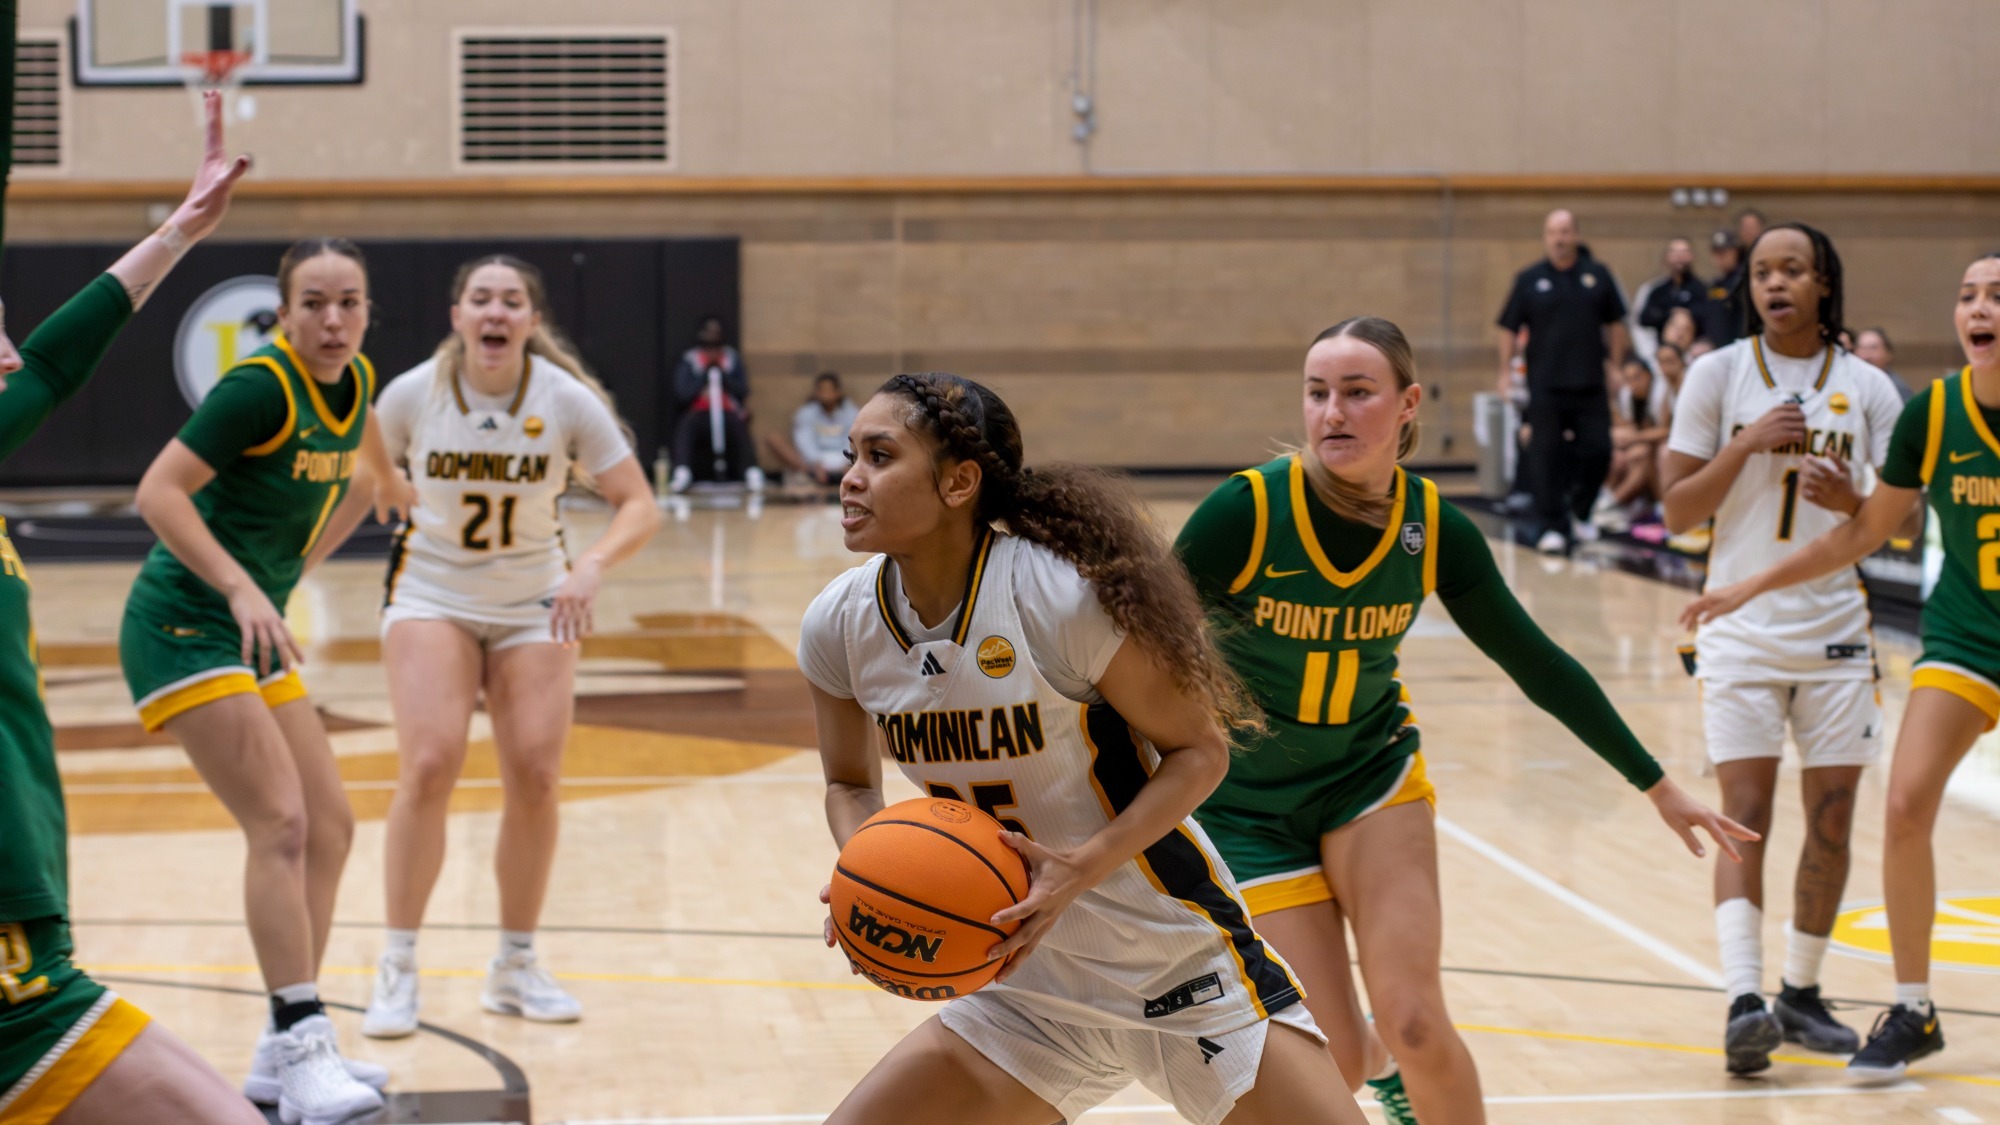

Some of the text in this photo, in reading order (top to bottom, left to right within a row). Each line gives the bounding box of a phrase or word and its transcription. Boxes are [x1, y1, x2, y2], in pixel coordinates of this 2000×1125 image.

[426, 451, 549, 482] DOMINICAN
[1950, 474, 2000, 507] POIN
[460, 493, 517, 550] 21
[1777, 468, 1799, 541] 1
[1254, 595, 1414, 641] POINT LOMA
[1297, 649, 1360, 725] 11
[925, 780, 1034, 842] 5
[849, 903, 945, 963] NCAA
[855, 895, 947, 935] OFFICIAL GAME BALL
